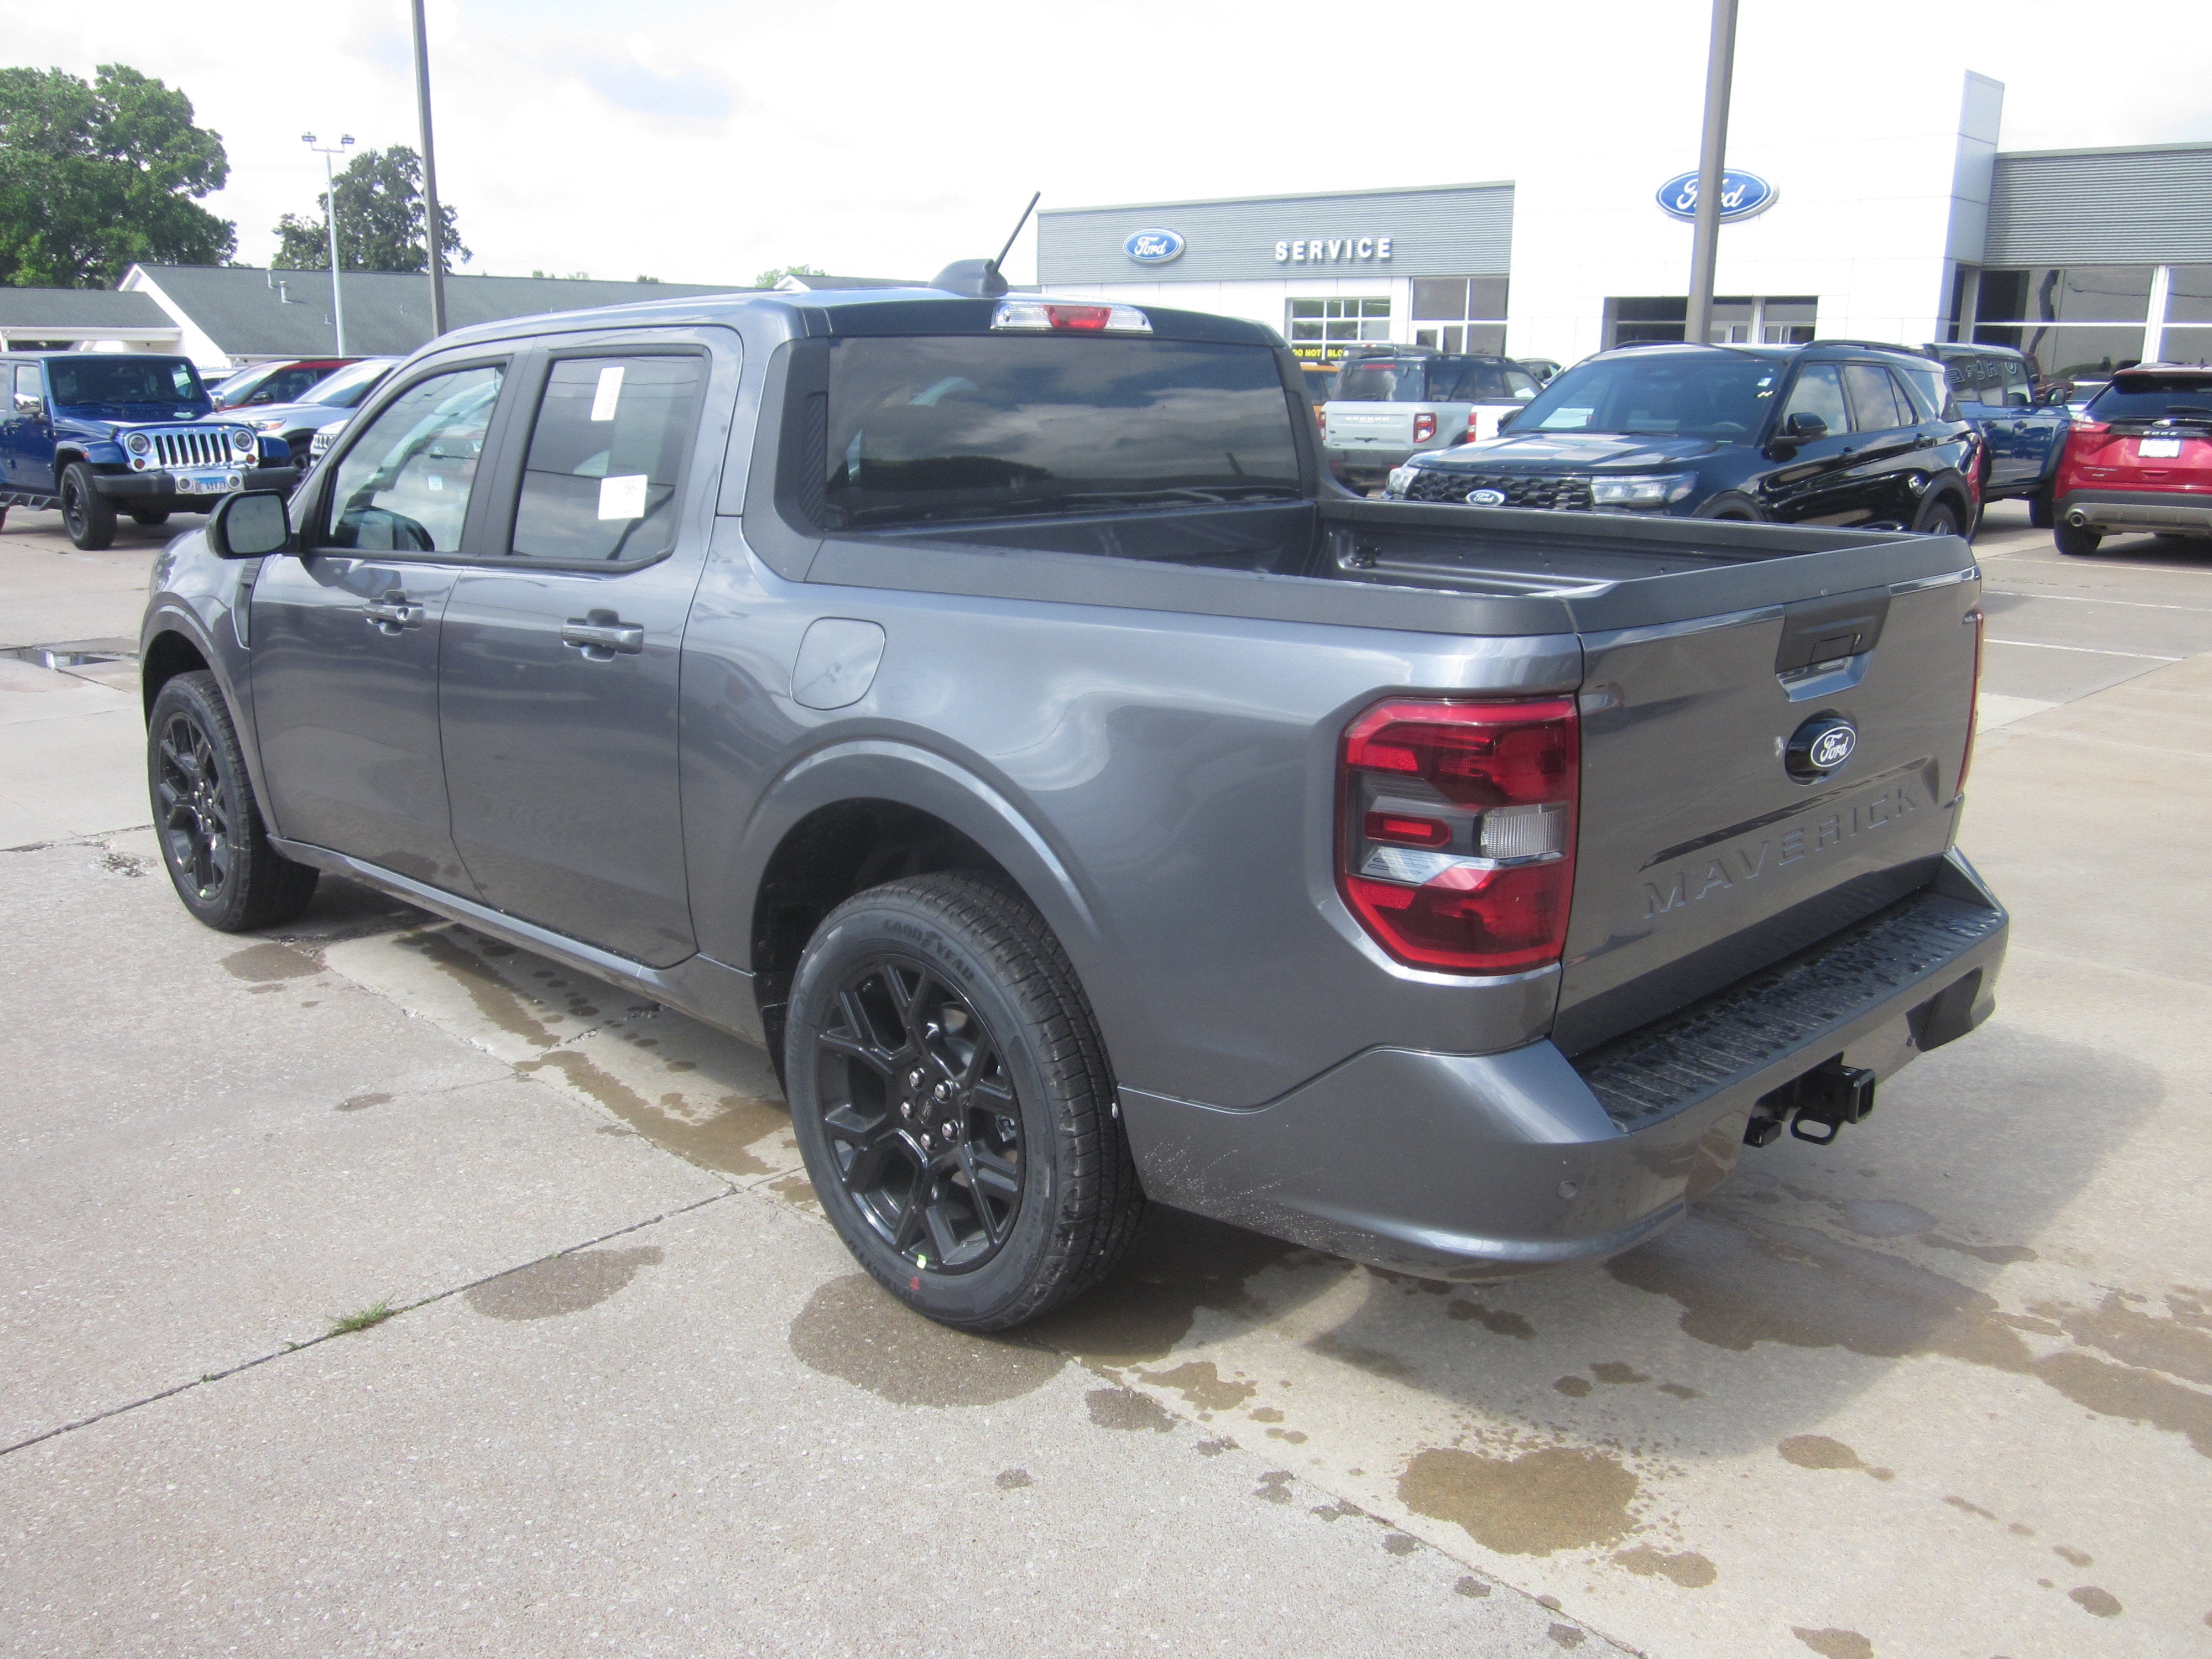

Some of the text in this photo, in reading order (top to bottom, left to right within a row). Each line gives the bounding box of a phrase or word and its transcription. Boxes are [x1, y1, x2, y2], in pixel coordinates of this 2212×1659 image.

[1676, 178, 1746, 210] Fd
[1134, 236, 1167, 255] Ford
[1275, 237, 1390, 262] SERVICE
[1292, 348, 1343, 357] DO NOT BLO
[1474, 492, 1494, 502] Ford
[1820, 732, 1849, 763] Ford
[1644, 784, 1917, 920] MAVERICK
